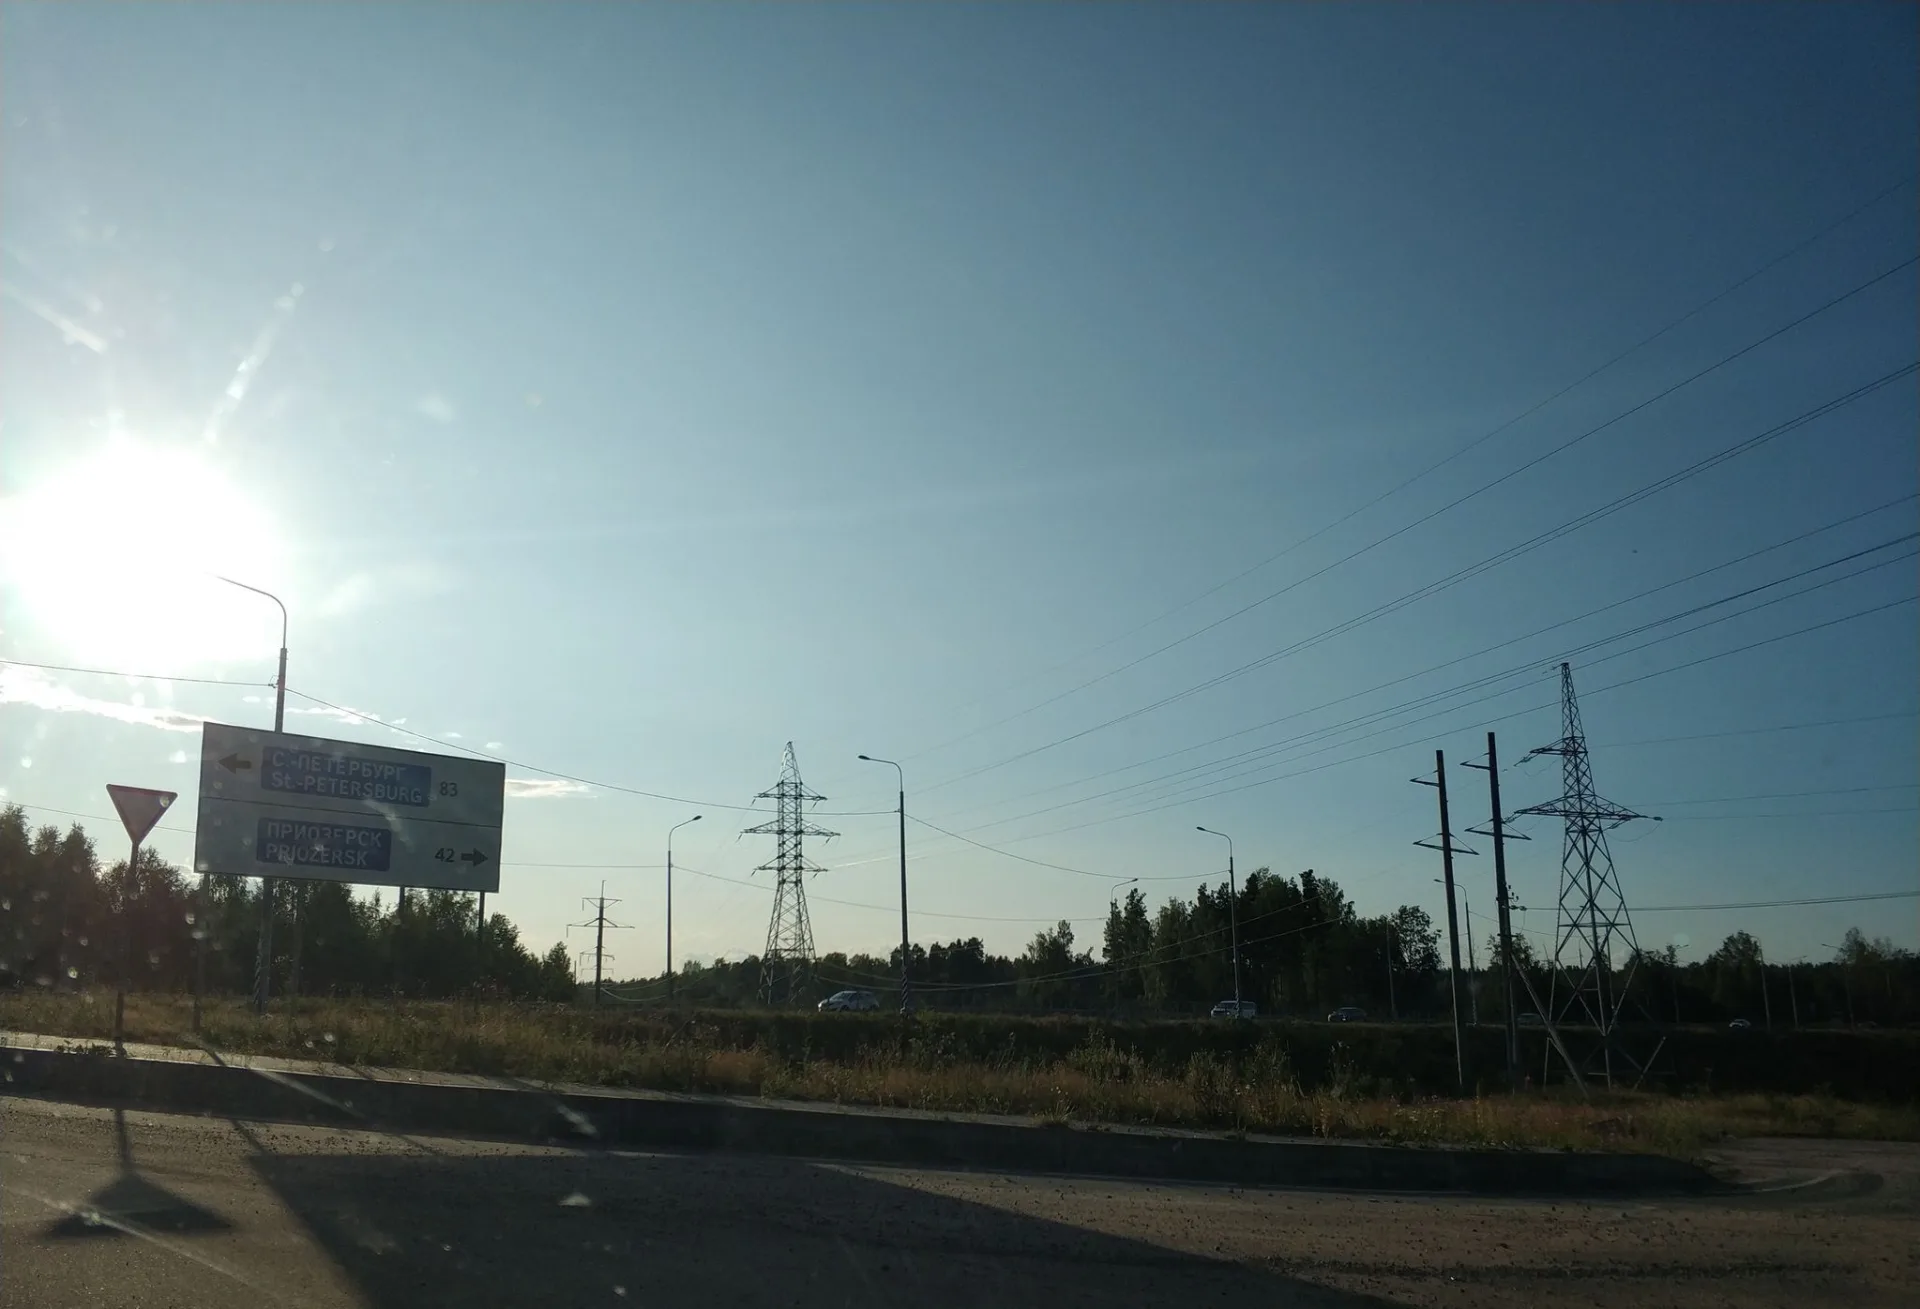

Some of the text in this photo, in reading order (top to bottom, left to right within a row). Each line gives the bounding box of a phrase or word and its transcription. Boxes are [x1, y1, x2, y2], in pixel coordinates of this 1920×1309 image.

[271, 772, 422, 803] St.-PETERSBURG
[439, 781, 458, 798] 83
[267, 822, 382, 848] ПРИОЗЕРСК
[434, 847, 455, 863] 42
